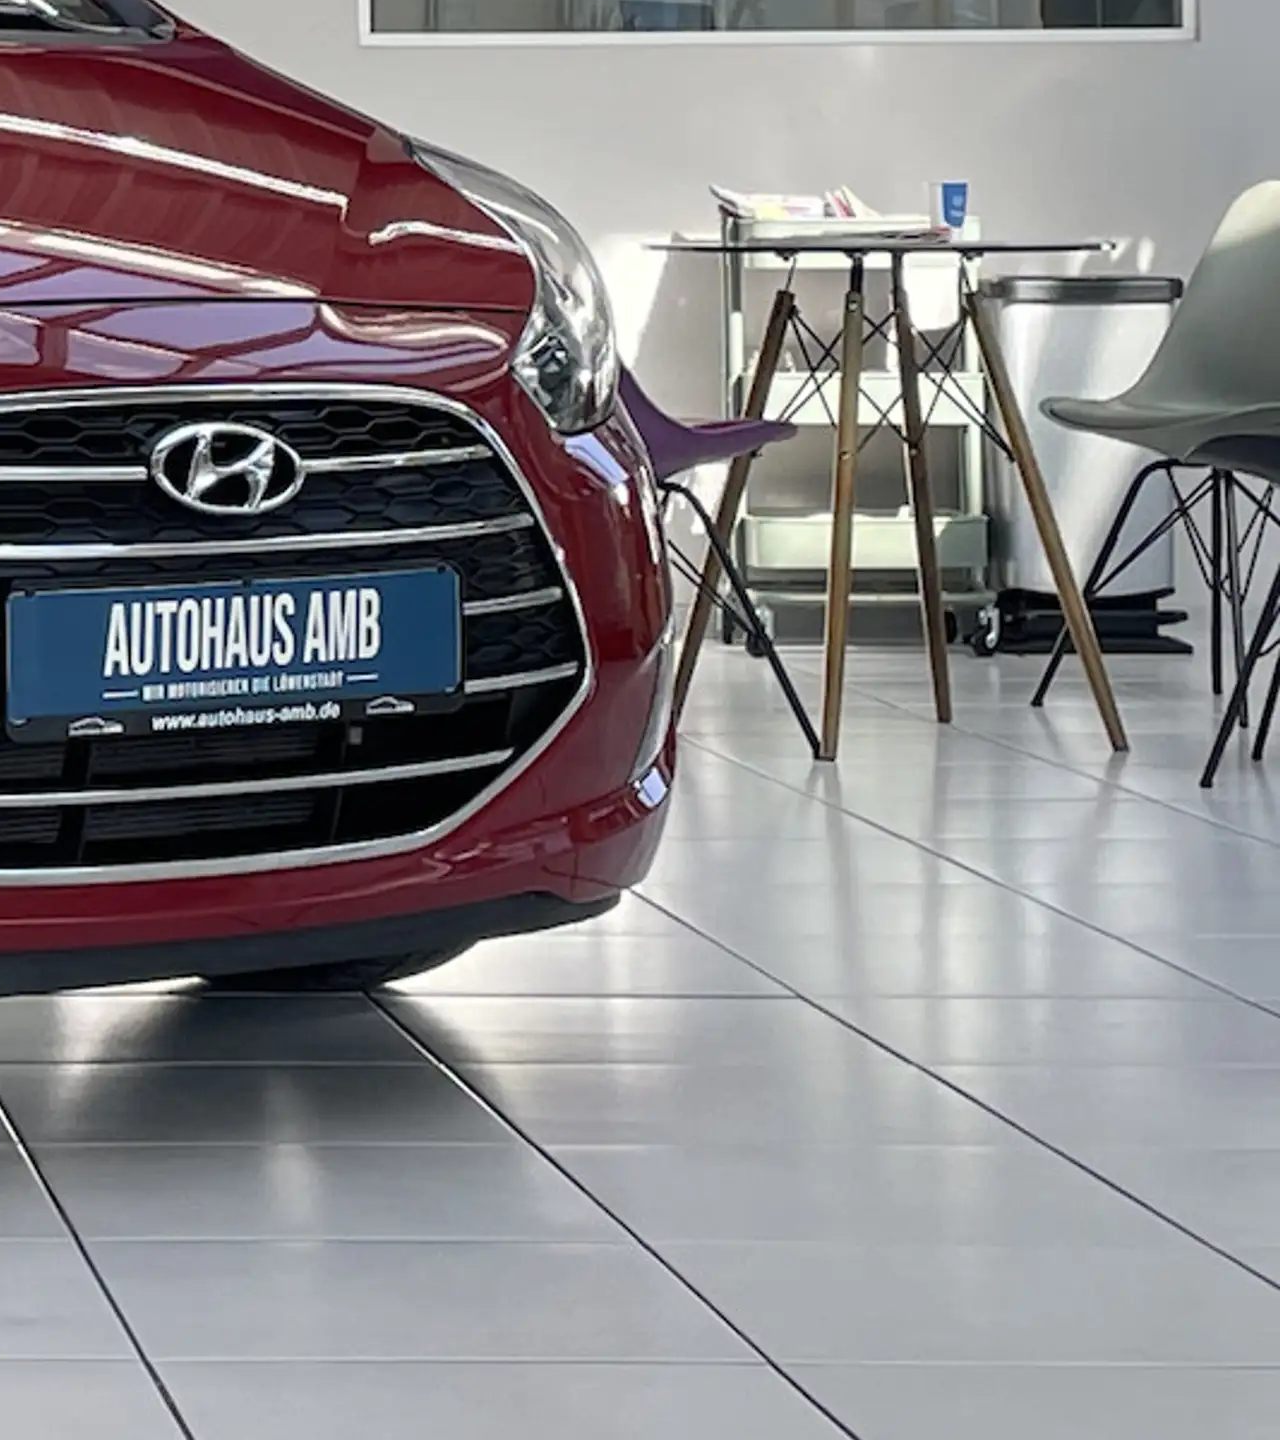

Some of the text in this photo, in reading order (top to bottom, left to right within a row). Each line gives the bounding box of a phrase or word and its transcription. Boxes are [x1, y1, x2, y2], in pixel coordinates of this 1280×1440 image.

[102, 587, 382, 677] AUTOHAUS AMB
[151, 701, 341, 731] www.autohaus-amb.de
